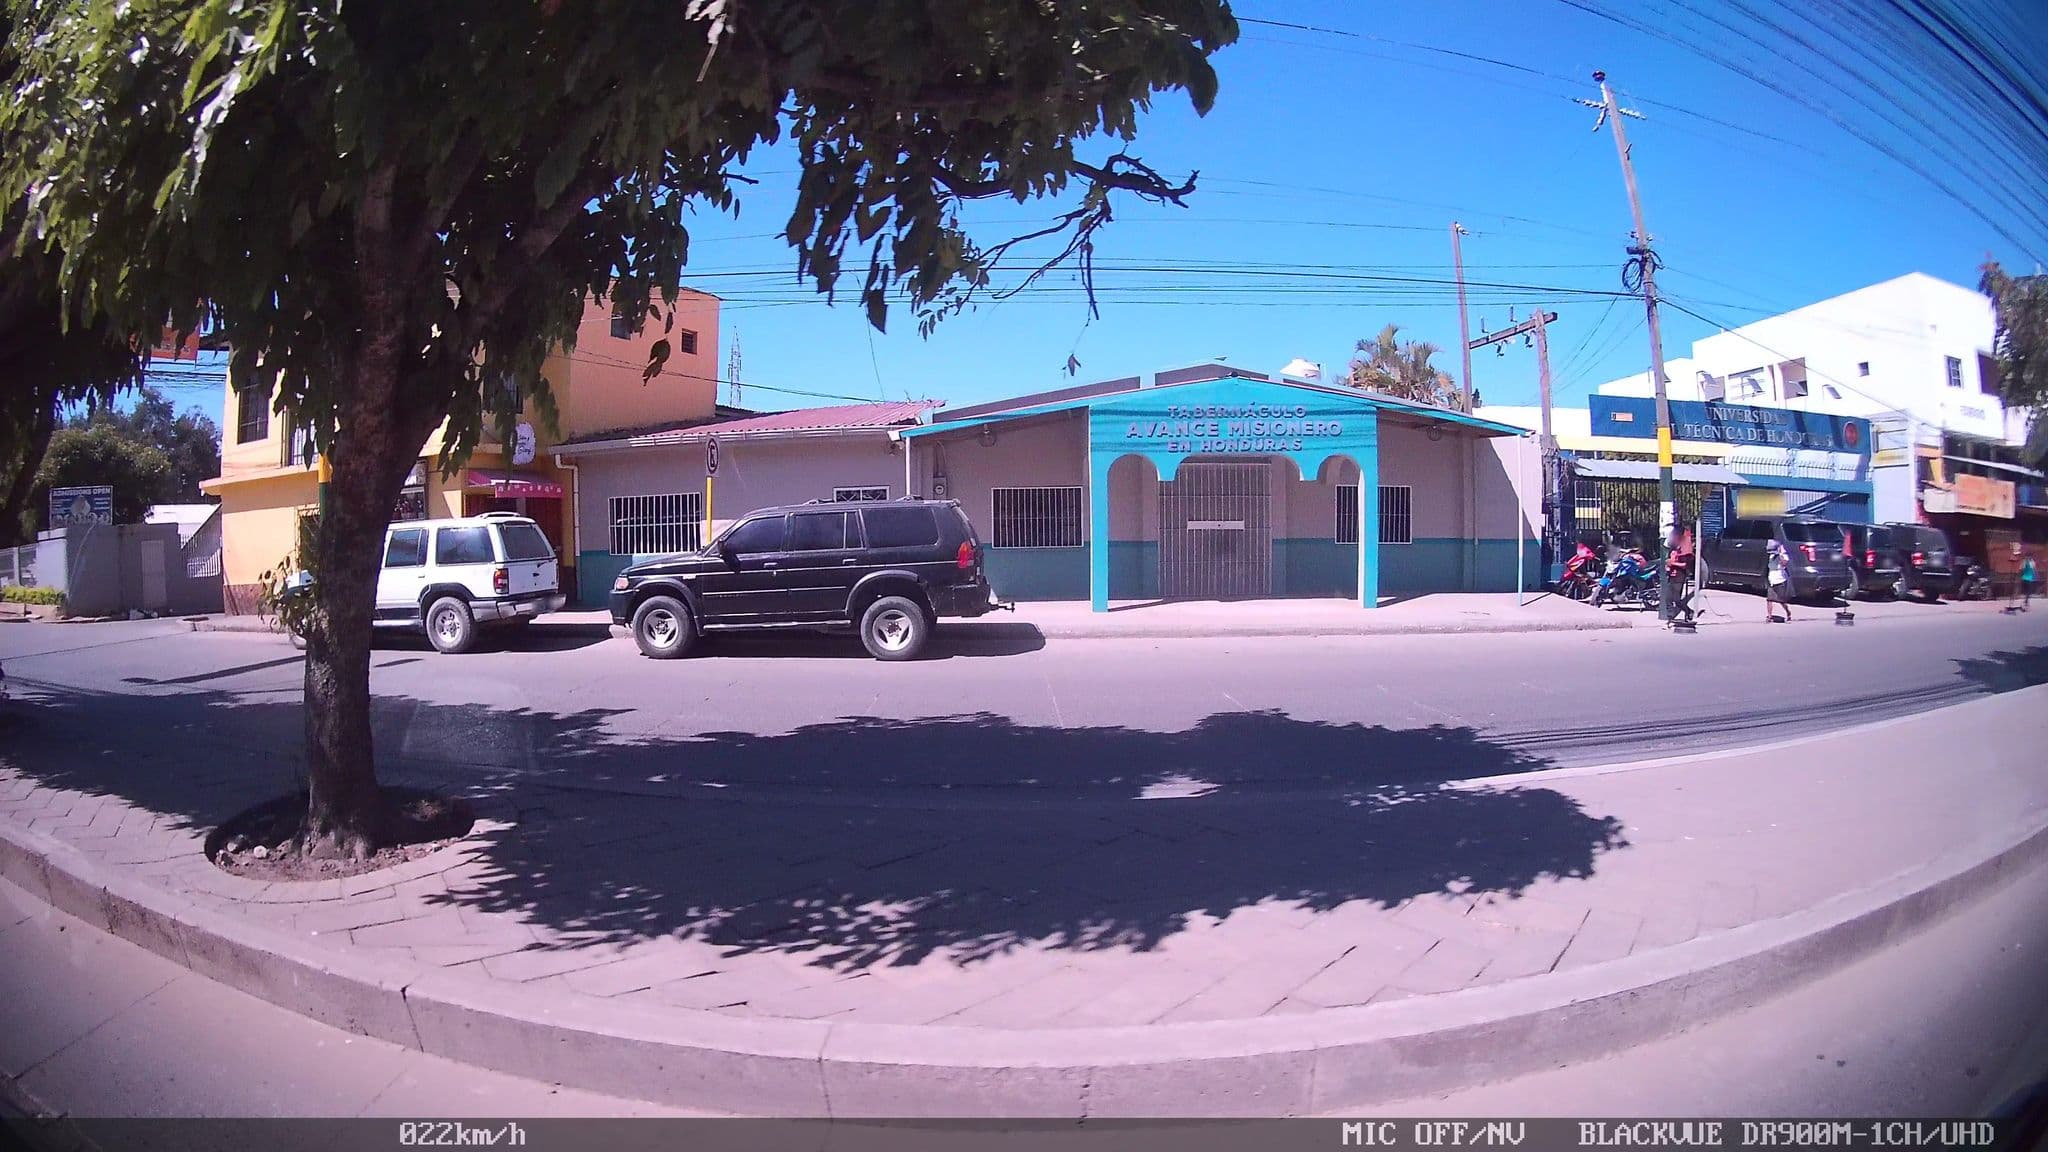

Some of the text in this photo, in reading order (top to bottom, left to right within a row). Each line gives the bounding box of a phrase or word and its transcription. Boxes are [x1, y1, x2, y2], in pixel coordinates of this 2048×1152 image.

[1126, 420, 1343, 438] AVANCE MISIONERO
[1747, 426, 1766, 442] DE
[1168, 439, 1303, 453] EN HONDURAS
